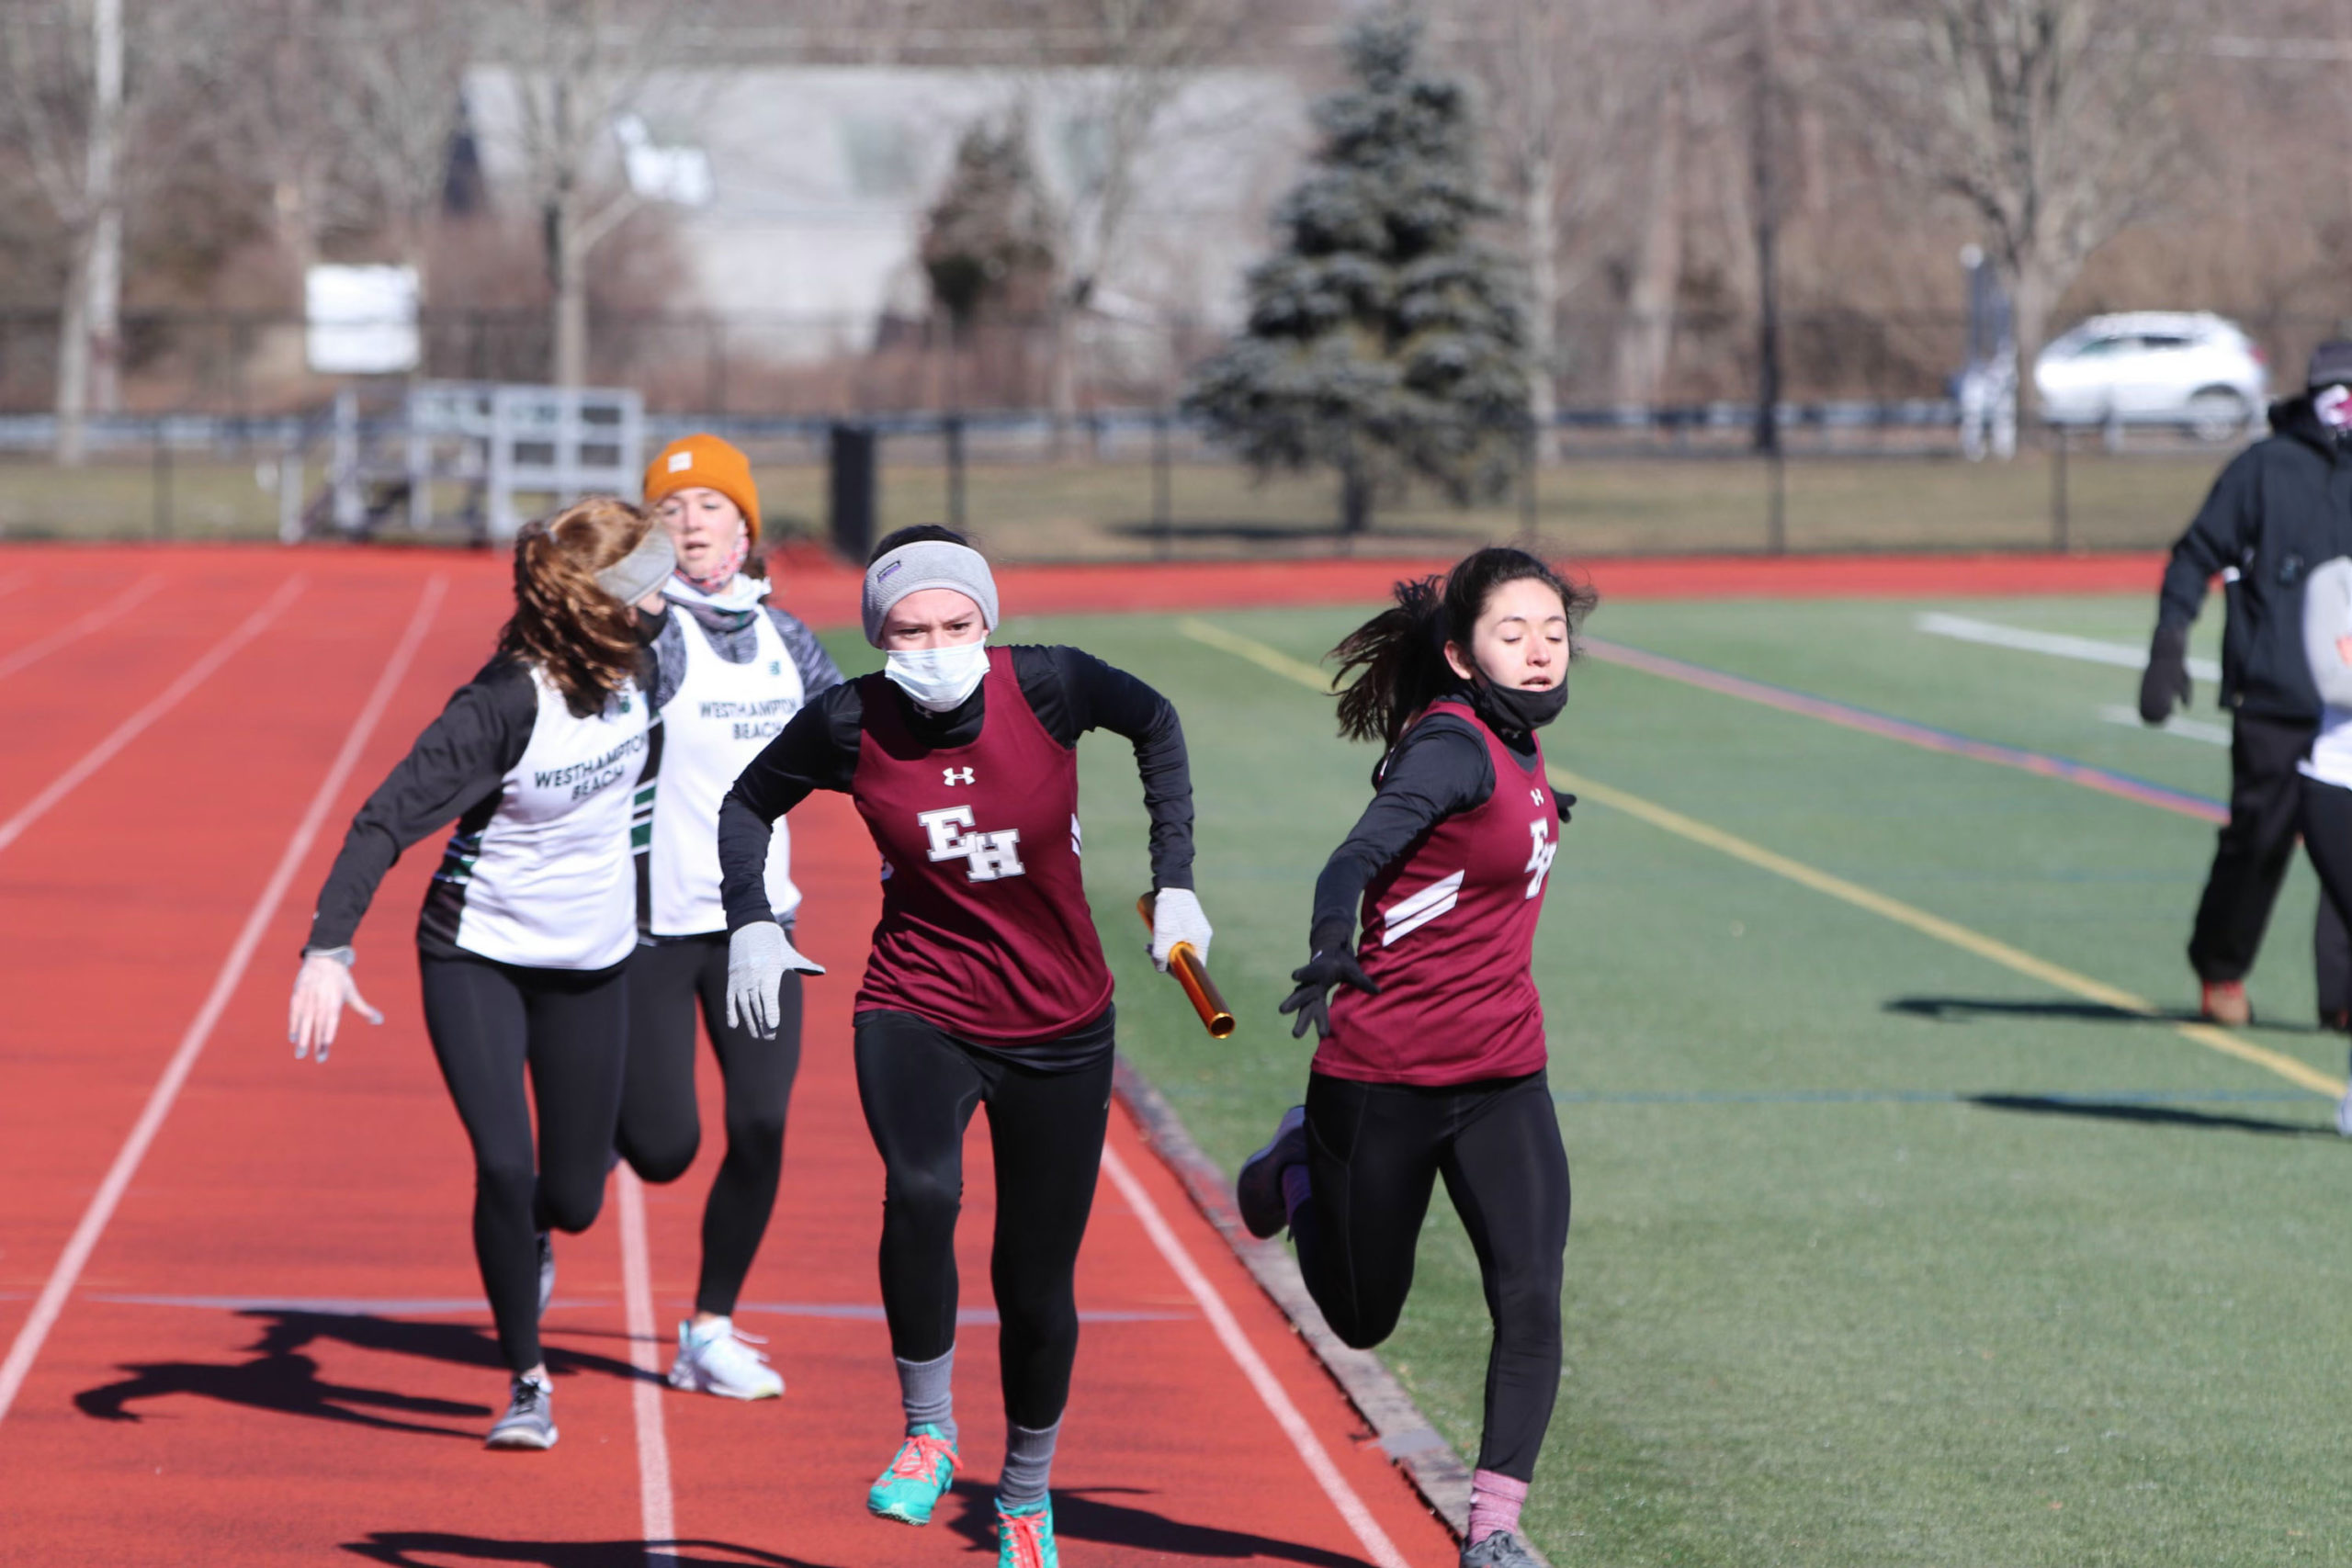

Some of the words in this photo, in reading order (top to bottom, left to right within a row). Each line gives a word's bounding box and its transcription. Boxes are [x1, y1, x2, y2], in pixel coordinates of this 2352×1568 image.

[699, 697, 797, 717] WESTHAMPTON
[571, 763, 624, 800] BEACH
[917, 805, 1025, 883] EH
